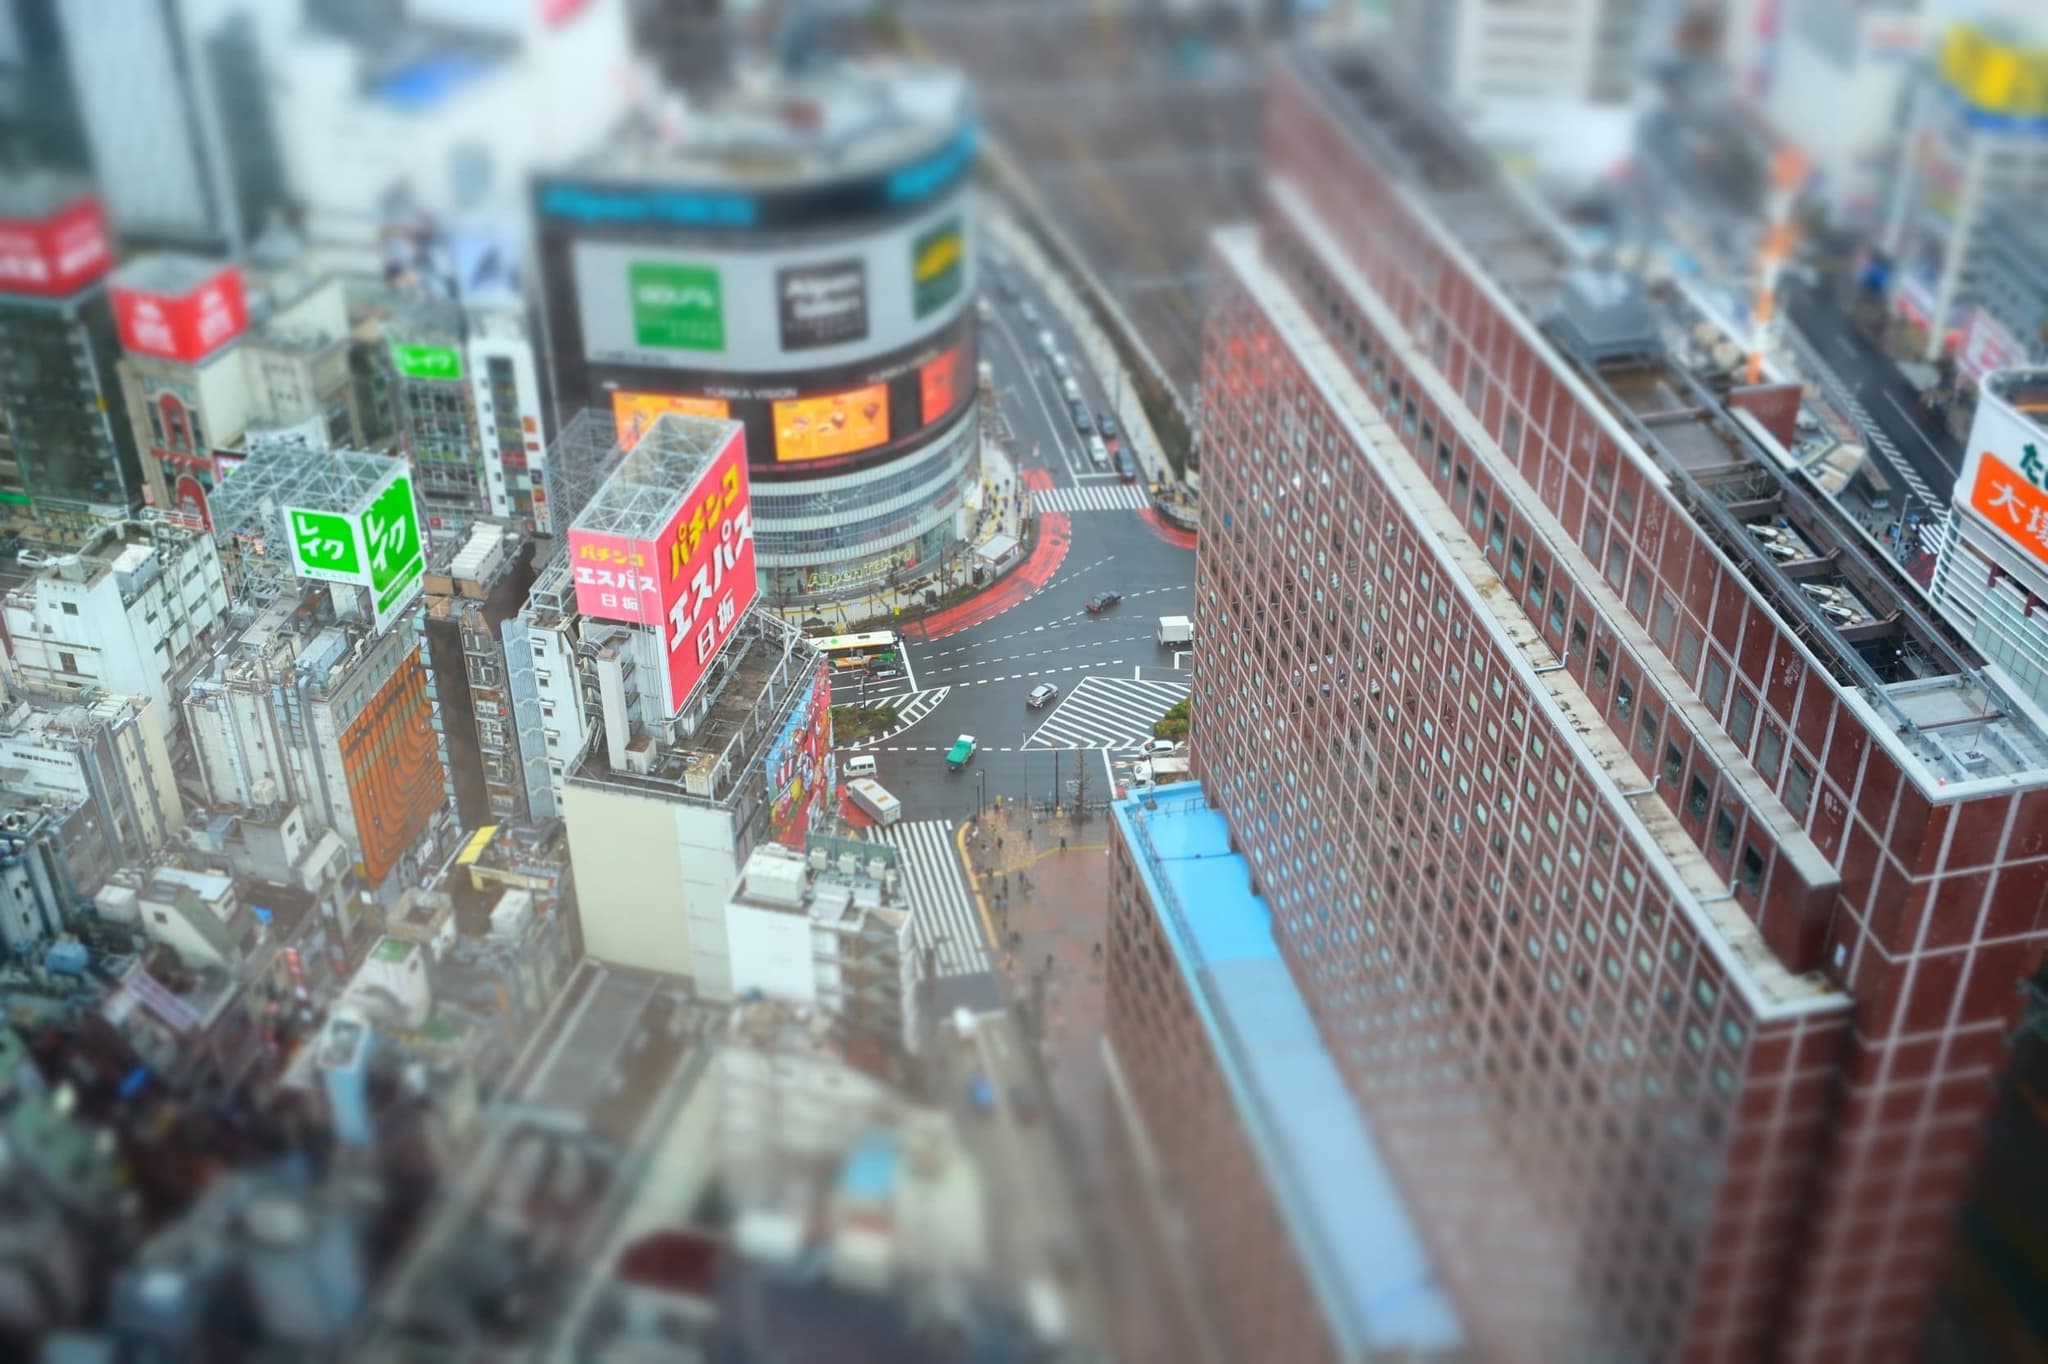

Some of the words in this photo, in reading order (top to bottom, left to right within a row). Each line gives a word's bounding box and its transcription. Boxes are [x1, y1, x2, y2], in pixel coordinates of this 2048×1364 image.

[580, 544, 645, 567] パチンコ
[671, 463, 740, 582] パチンコ
[576, 567, 657, 593] エスパス
[669, 504, 753, 653] エスパス
